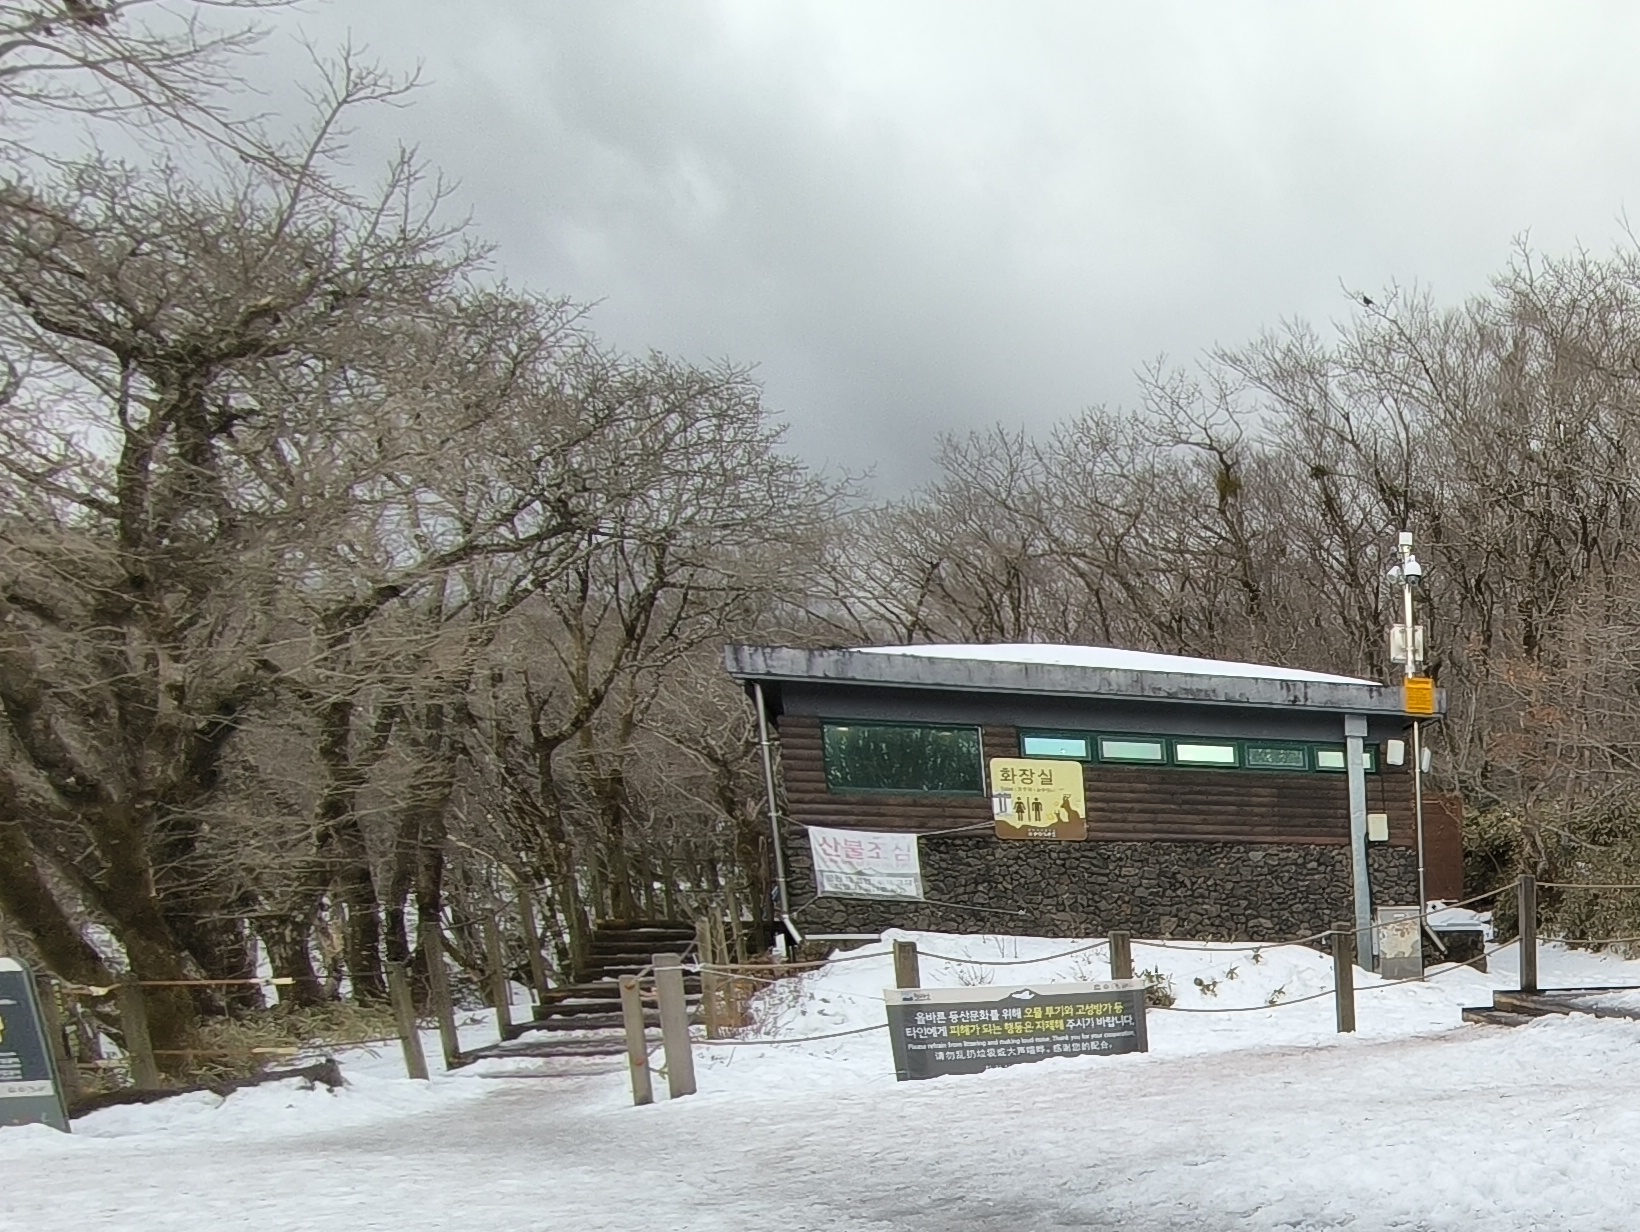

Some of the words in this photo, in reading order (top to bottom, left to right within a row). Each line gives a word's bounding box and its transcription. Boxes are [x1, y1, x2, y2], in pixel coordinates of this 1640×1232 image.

[999, 767, 1053, 786] 화장실
[818, 836, 911, 862] 산불조심
[914, 1011, 947, 1025] 올바른
[948, 1009, 1000, 1023] 등산문화를
[1001, 1008, 1022, 1020] 위해
[1023, 1007, 1042, 1019] 오물
[1045, 1005, 1074, 1017] 투기와
[1075, 1002, 1112, 1016] 고성방가
[1113, 1002, 1124, 1014] 등
[905, 1025, 948, 1039] 타인에게
[949, 1023, 981, 1036] 피해가
[981, 1023, 1002, 1035] 되는
[1004, 1021, 1034, 1034] 행동은
[1066, 1017, 1095, 1031] 주시기
[1096, 1014, 1135, 1028] 바랍니다.
